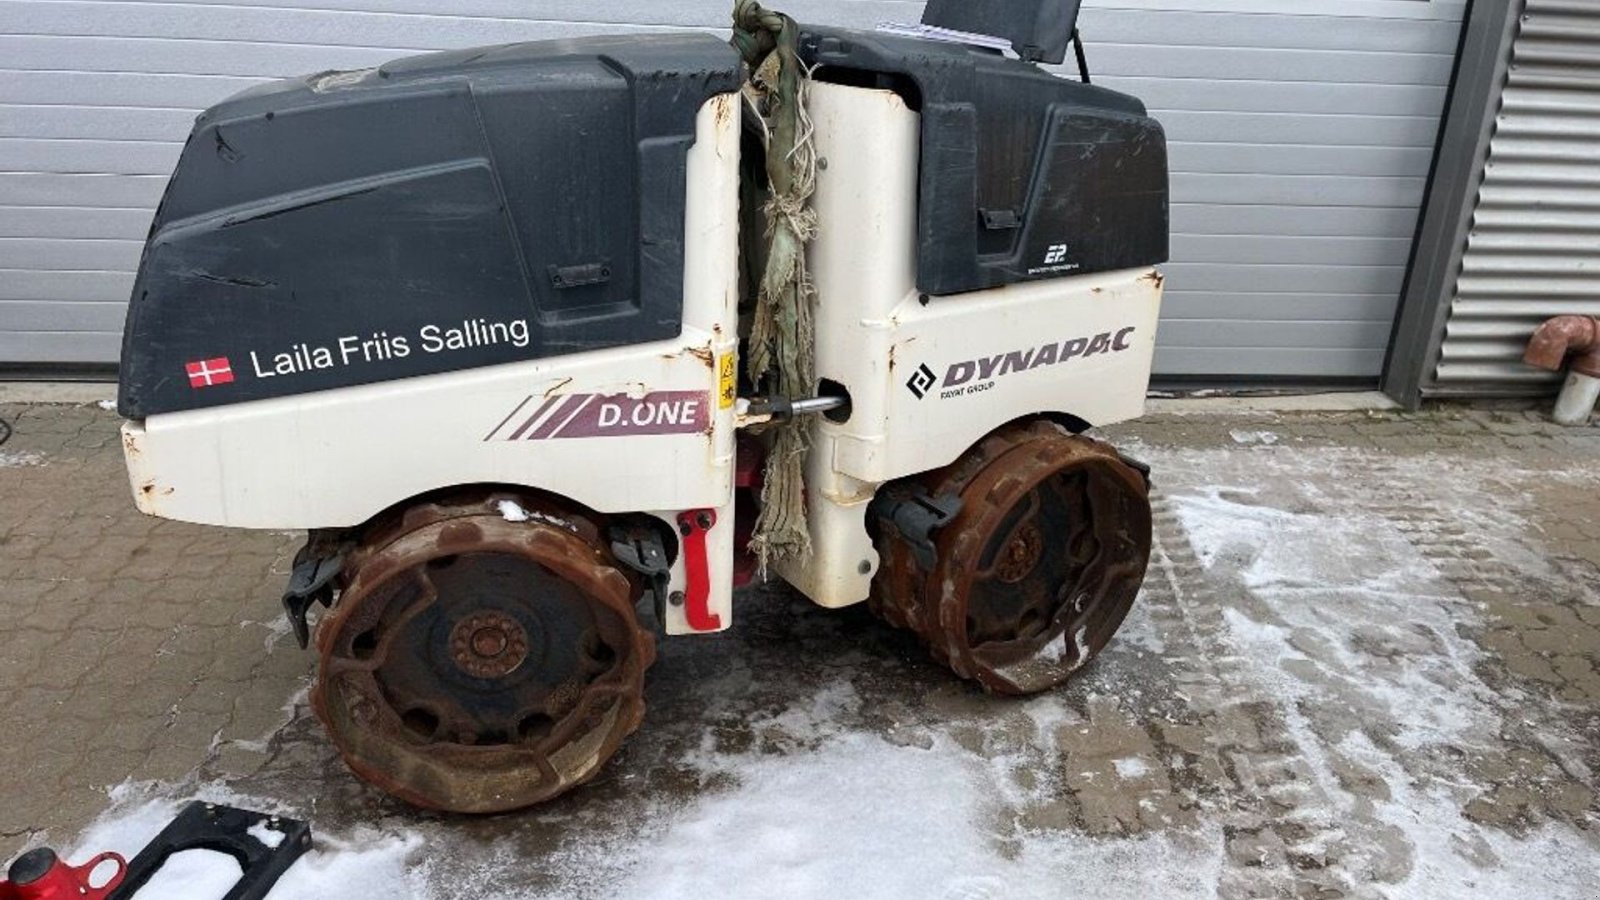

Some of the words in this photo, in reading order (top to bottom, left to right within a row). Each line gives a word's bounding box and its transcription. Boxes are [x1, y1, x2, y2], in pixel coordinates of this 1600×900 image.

[250, 344, 334, 378] Laila
[338, 331, 411, 366] Friis
[420, 318, 529, 352] Salling
[942, 326, 1136, 388] DYNAPAC
[940, 387, 965, 400] FAYAT
[967, 381, 995, 395] GROUP
[598, 401, 699, 428] D.ONE
